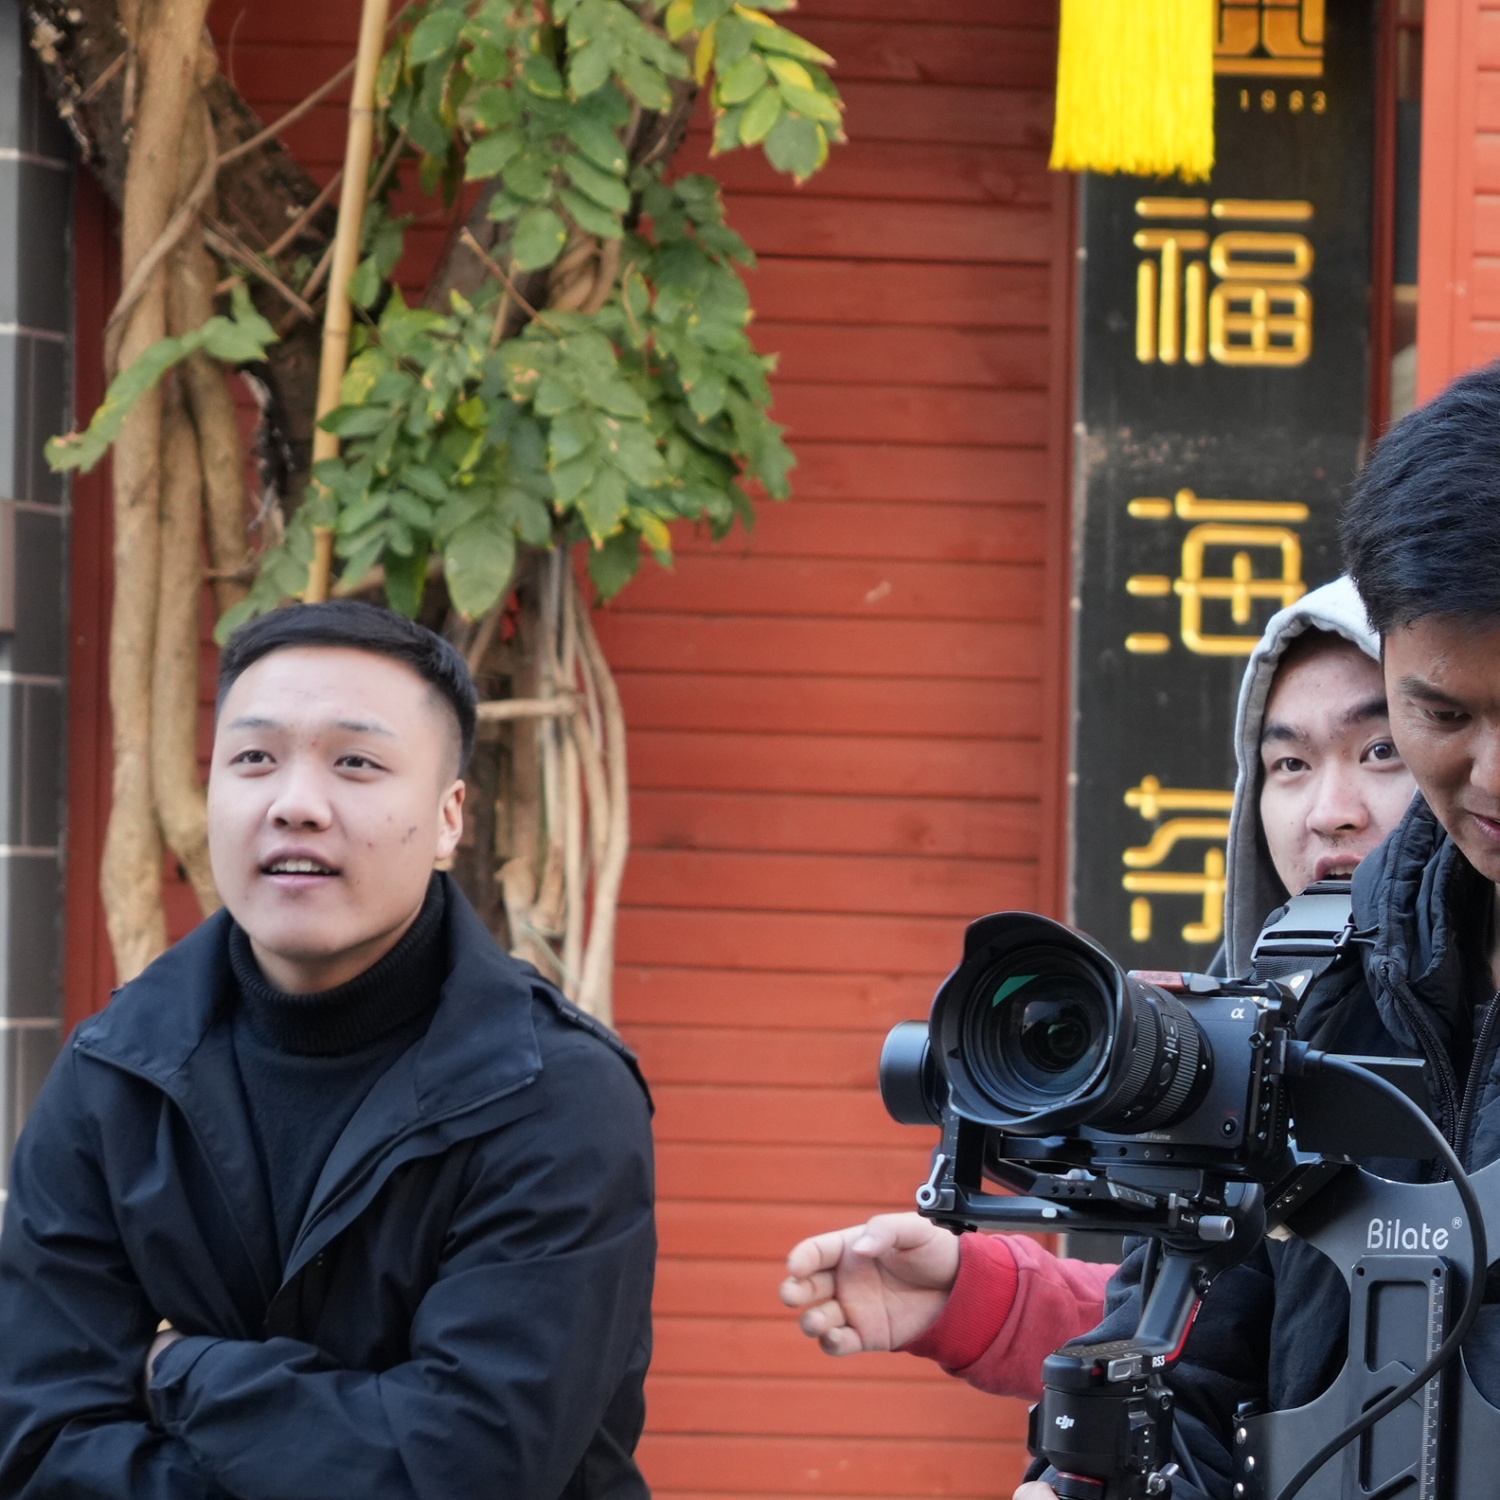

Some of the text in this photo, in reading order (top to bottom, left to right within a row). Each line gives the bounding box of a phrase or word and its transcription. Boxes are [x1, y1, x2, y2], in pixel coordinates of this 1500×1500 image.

[1366, 1217, 1449, 1250] Bilate
[1152, 1355, 1166, 1368] RS3
[1055, 1415, 1075, 1430] dji
